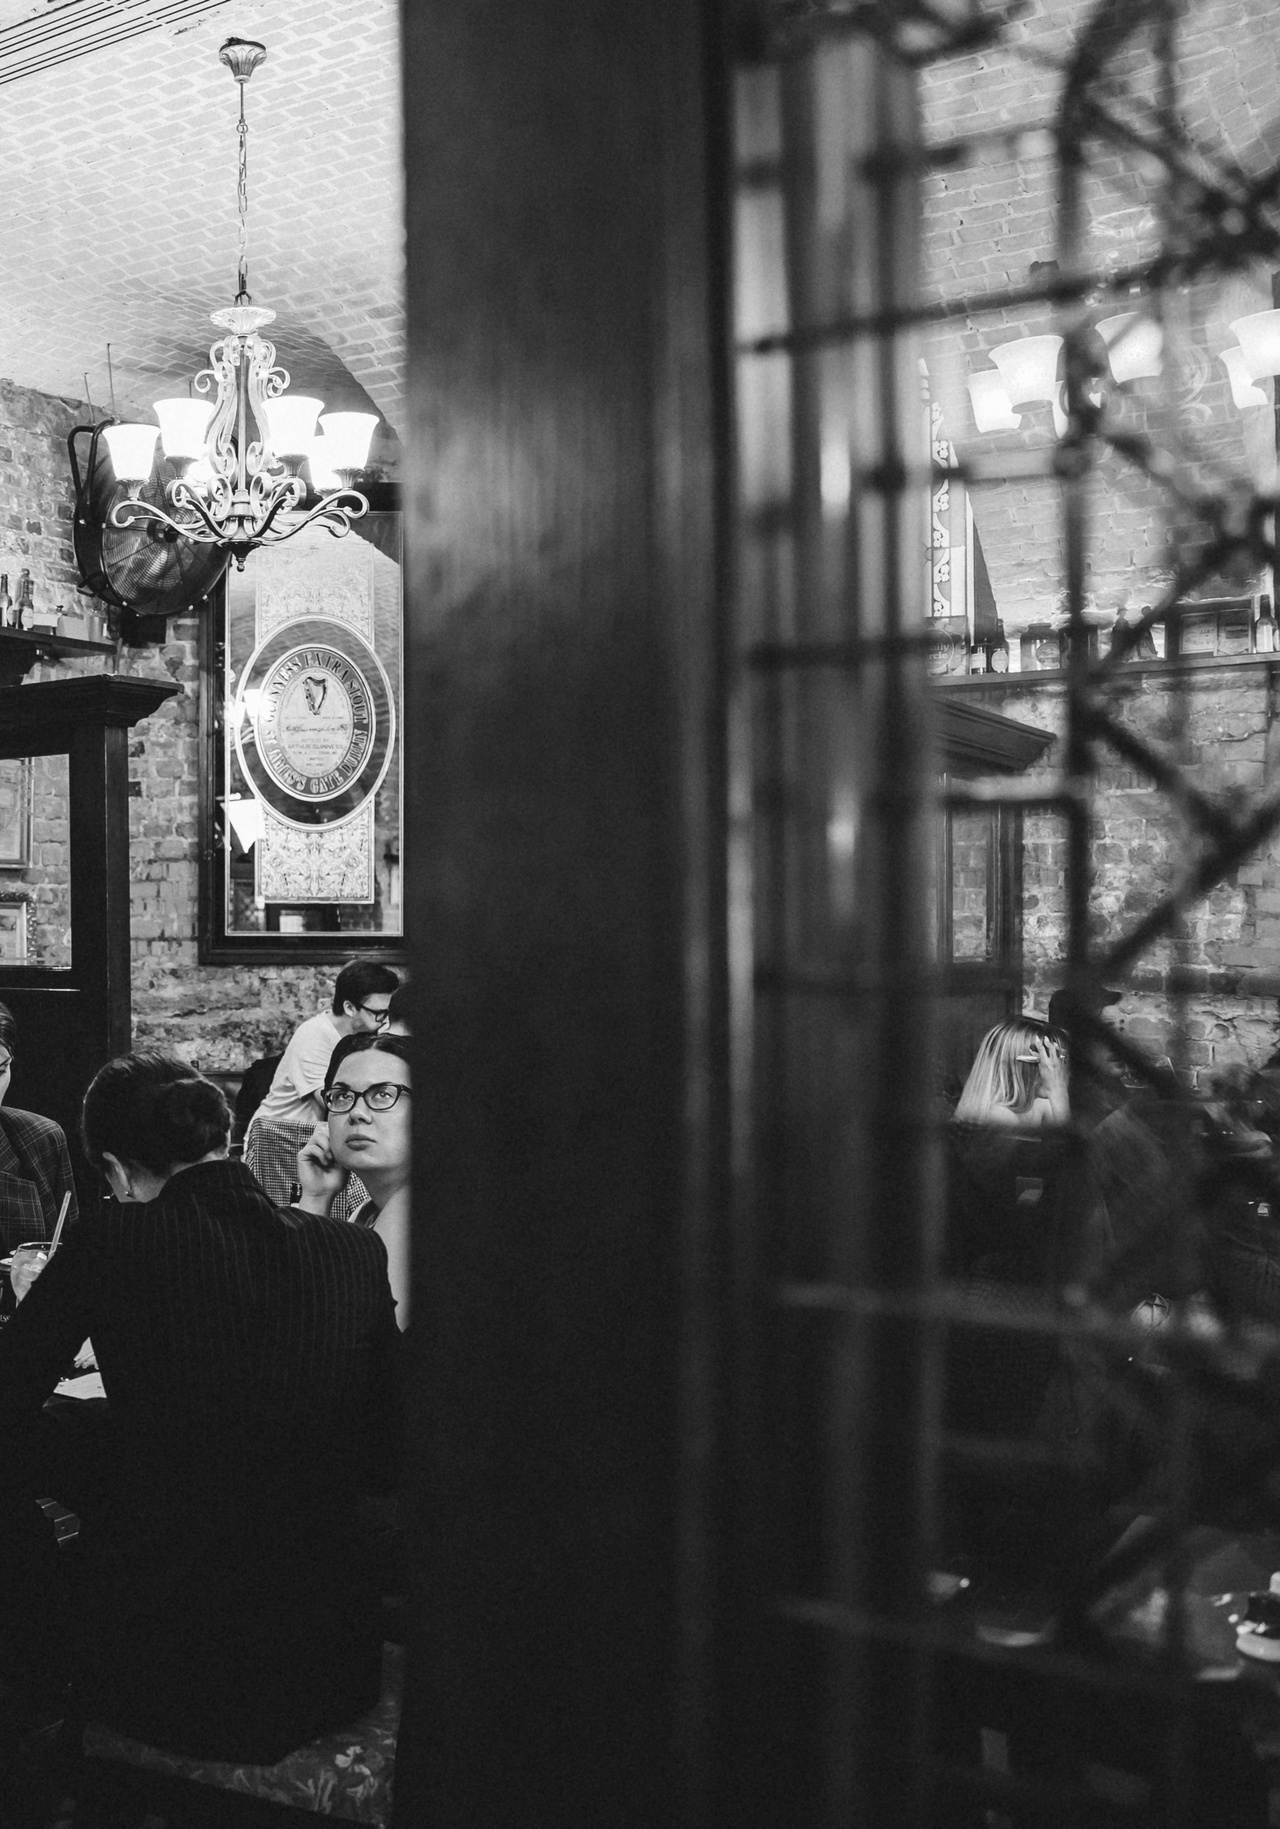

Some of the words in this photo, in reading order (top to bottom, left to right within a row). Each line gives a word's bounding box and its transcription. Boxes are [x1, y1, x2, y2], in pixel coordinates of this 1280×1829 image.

[302, 651, 349, 682] EXTRA
[344, 679, 370, 725] STOUT
[309, 769, 345, 794] GATE
[339, 728, 368, 777] DUBLIN
